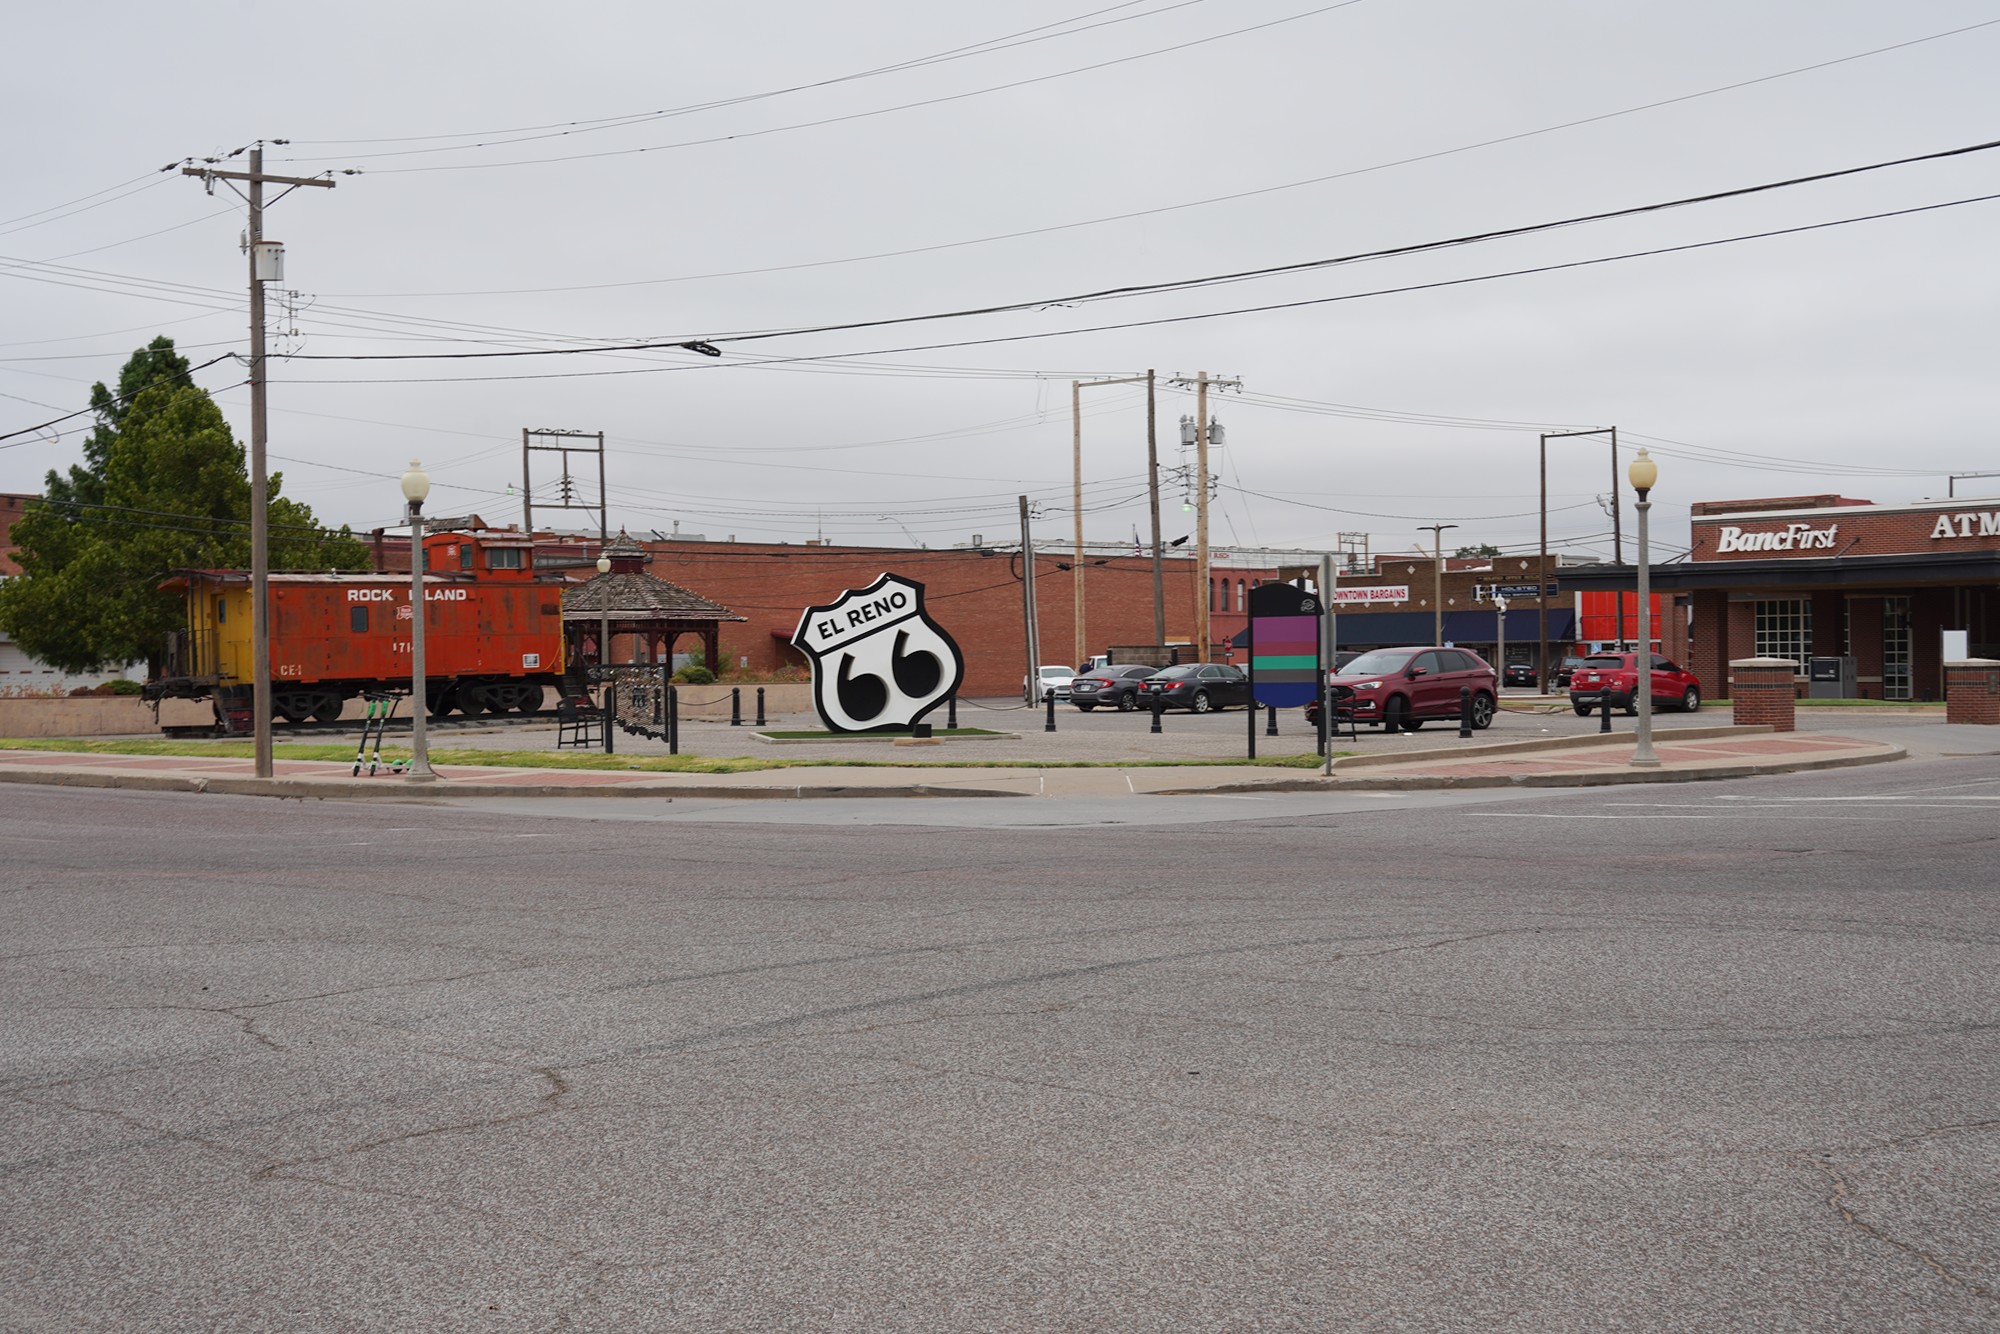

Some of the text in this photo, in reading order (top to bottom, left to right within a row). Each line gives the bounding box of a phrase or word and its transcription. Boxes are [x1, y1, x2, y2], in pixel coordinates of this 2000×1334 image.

[1717, 524, 1838, 553] BancFirst
[347, 589, 466, 601] ROCK ILAND
[1370, 588, 1406, 599] BARGAINS
[817, 592, 907, 640] EL RENO
[393, 642, 414, 653] 171
[837, 629, 945, 721] 66
